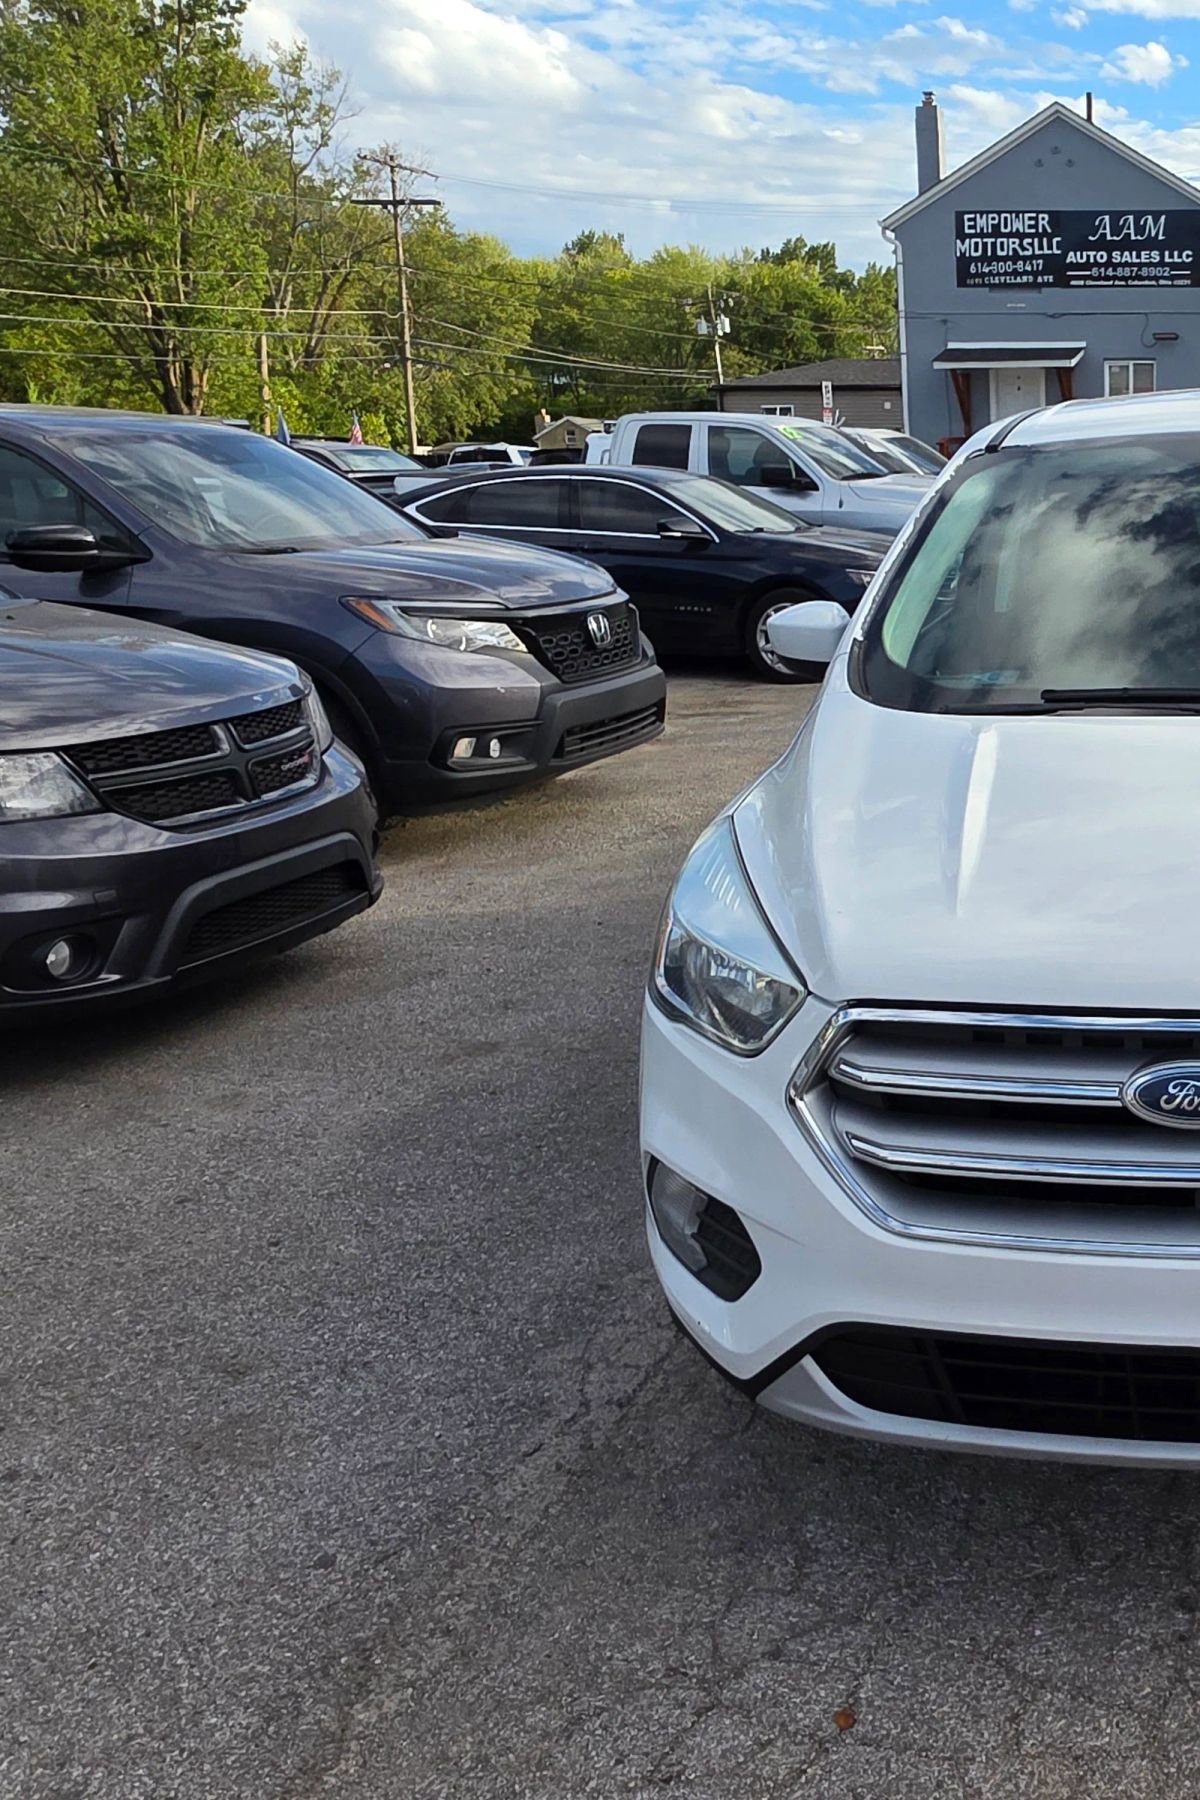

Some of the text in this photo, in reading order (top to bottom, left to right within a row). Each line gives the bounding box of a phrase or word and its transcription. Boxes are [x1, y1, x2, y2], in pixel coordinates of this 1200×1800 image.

[963, 213, 1052, 234] EMPOWER
[1088, 214, 1166, 241] AAM
[1065, 251, 1193, 263] AUTO SALES LLC
[1091, 267, 1170, 277] 614-887-8902
[984, 276, 1034, 285] CLEVELAND
